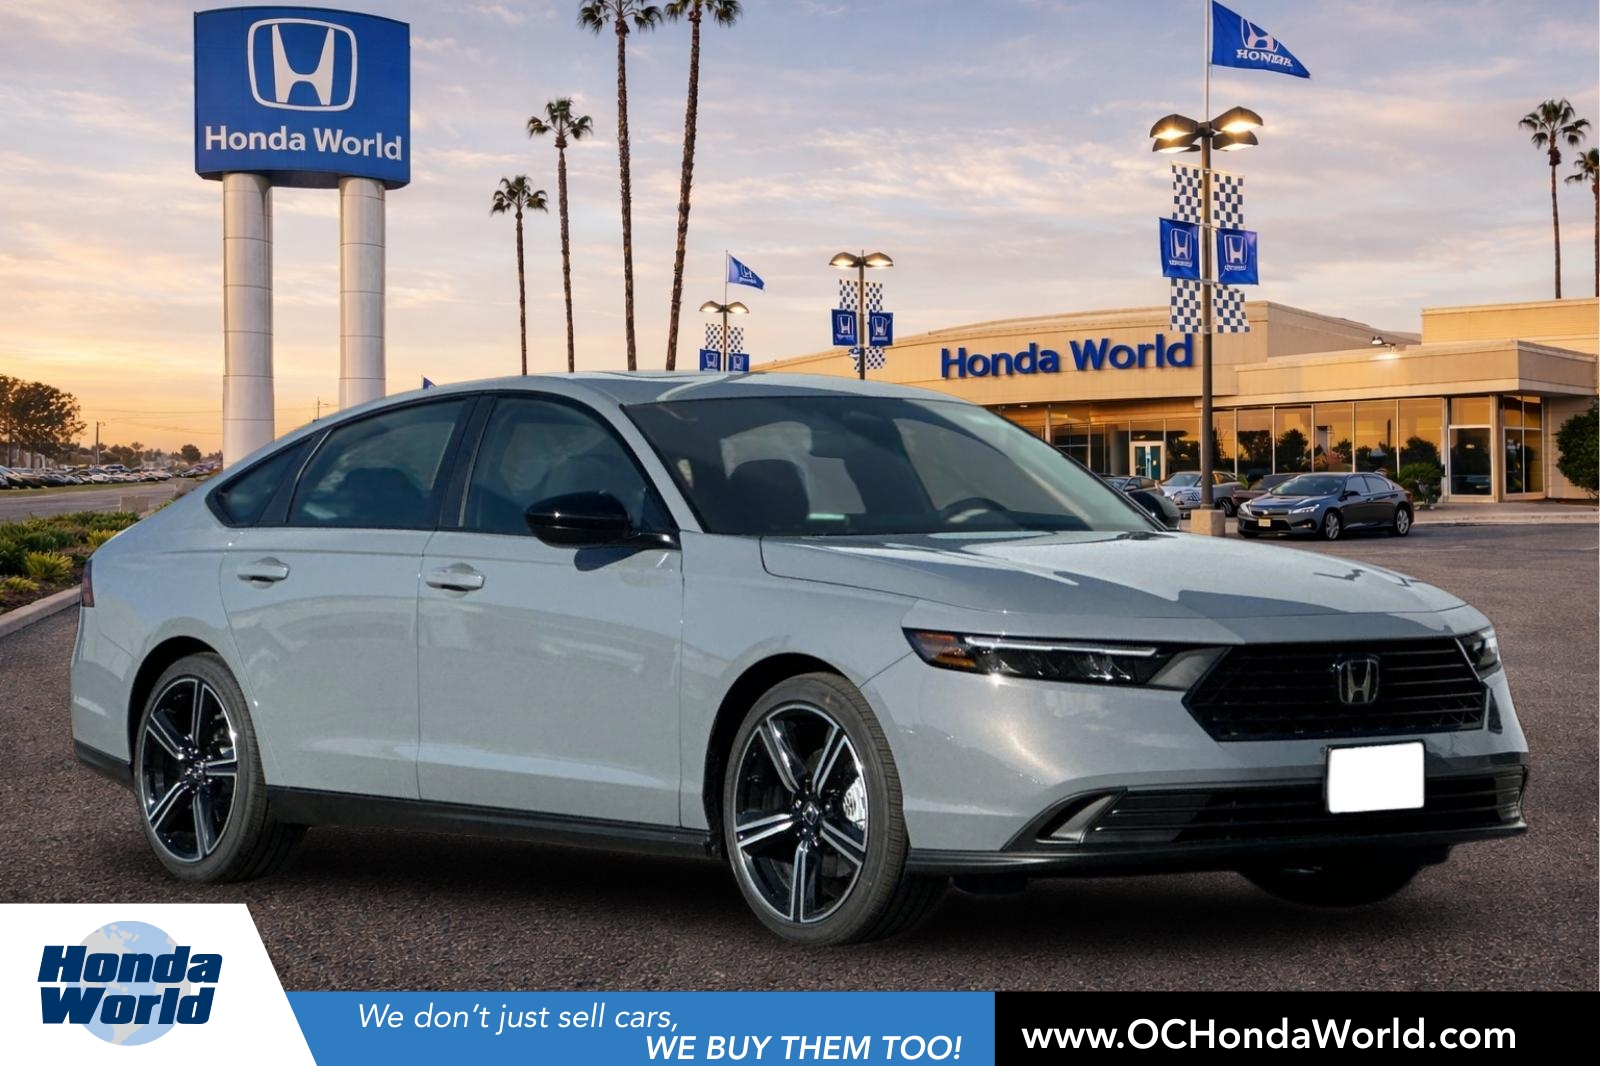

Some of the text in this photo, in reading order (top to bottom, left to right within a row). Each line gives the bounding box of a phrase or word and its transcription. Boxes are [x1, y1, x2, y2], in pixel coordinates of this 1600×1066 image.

[205, 125, 402, 161] Honda World
[940, 333, 1194, 378] Honda World
